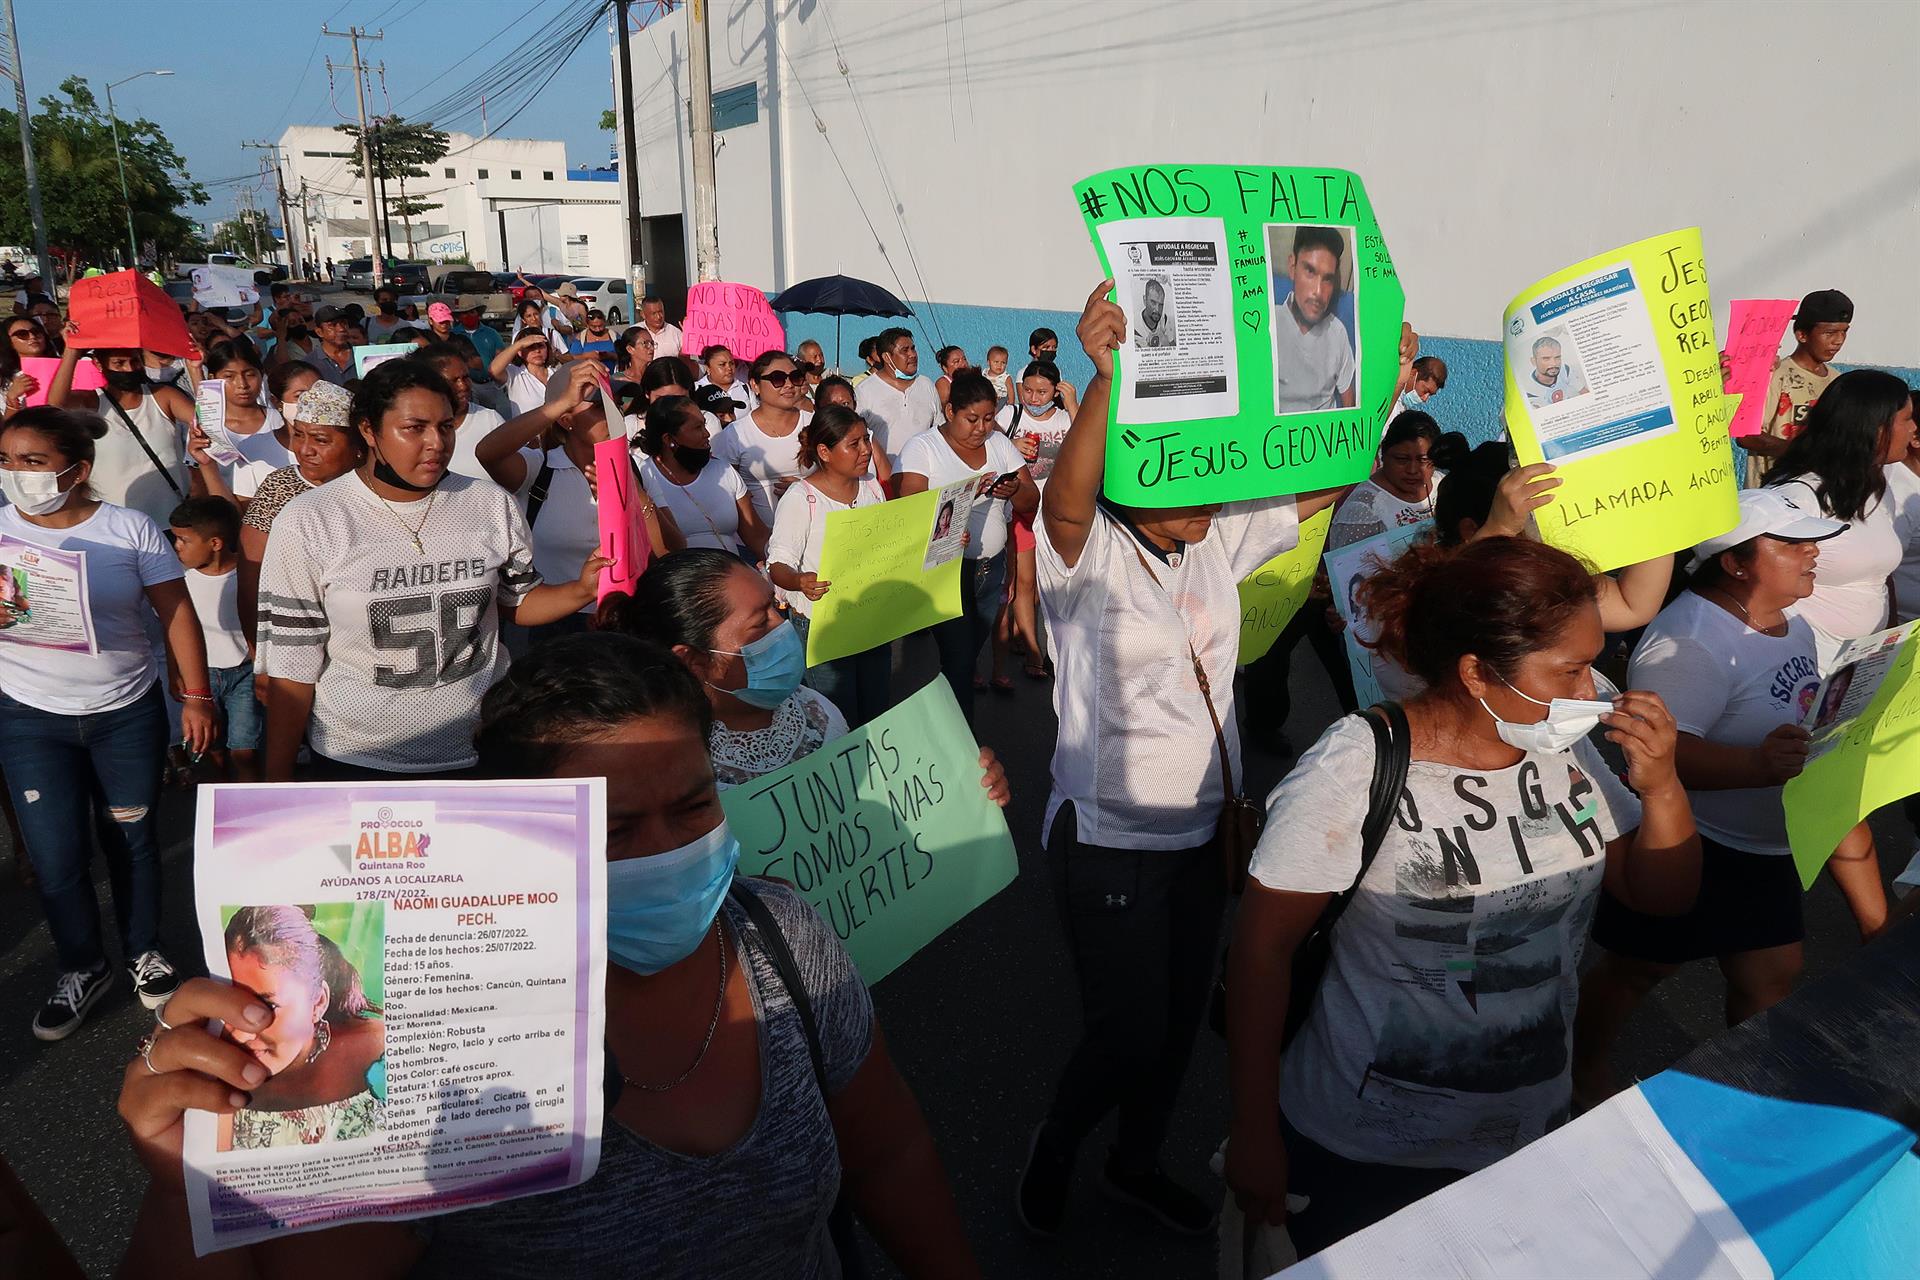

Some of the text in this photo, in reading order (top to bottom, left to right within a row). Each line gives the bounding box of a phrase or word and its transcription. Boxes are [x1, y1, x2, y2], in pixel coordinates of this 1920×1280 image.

[1081, 168, 1361, 222] #NOS FALTA
[1239, 245, 1254, 254] TU
[1235, 275, 1248, 286] TE
[1365, 267, 1377, 278] TE
[693, 286, 715, 305] NO
[1243, 285, 1264, 299] AMA
[742, 315, 769, 337] NOS
[1693, 389, 1718, 408] ABRIL
[1560, 480, 1673, 526] LLAMADA
[370, 559, 485, 592] RAIDERS
[368, 584, 492, 690] 58
[749, 728, 900, 855] JUNTAS
[888, 757, 944, 831] MÁS
[360, 820, 423, 830] PROOCOLO
[355, 831, 420, 859] ALBA
[359, 861, 425, 871] Quintana Roo
[320, 875, 381, 888] AYÚDANOS
[395, 874, 464, 884] LOCALIZARLA
[814, 832, 933, 940] UERTES
[393, 892, 558, 910] NAOMI GUADALUPE MOO
[457, 912, 497, 926] PECH.
[384, 929, 528, 944] Fecha de denuncia: 26/07/2022.
[384, 941, 536, 958] Fecha de los hechos: 25/07/2022.
[384, 960, 453, 972] Edad: 15 años.
[384, 973, 473, 985] Género: Femenina.
[384, 977, 567, 999] Lugar de los hechos: Cancún, Quintana
[384, 1002, 407, 1010] Roo.
[385, 1004, 498, 1021] Nacionalidad: Mexicana.
[407, 1020, 444, 1029] Morena.
[386, 1025, 485, 1045] Complexión: Robusta
[386, 1028, 565, 1057] Cabello: Negro, lacio y corto arriba de
[386, 1057, 448, 1070] los hombros.
[386, 1061, 498, 1083] Ojos Color: café oscuro.
[387, 1070, 514, 1095] Estatura: 1.65 metros aprox.
[387, 1087, 483, 1107] Peso: 75 kilos aprox.
[387, 1084, 565, 1119] Señas particulares: Cicatriz en el
[387, 1097, 565, 1131] abdomen de lado derecho por cirugía
[388, 1128, 447, 1142] de apéndice.
